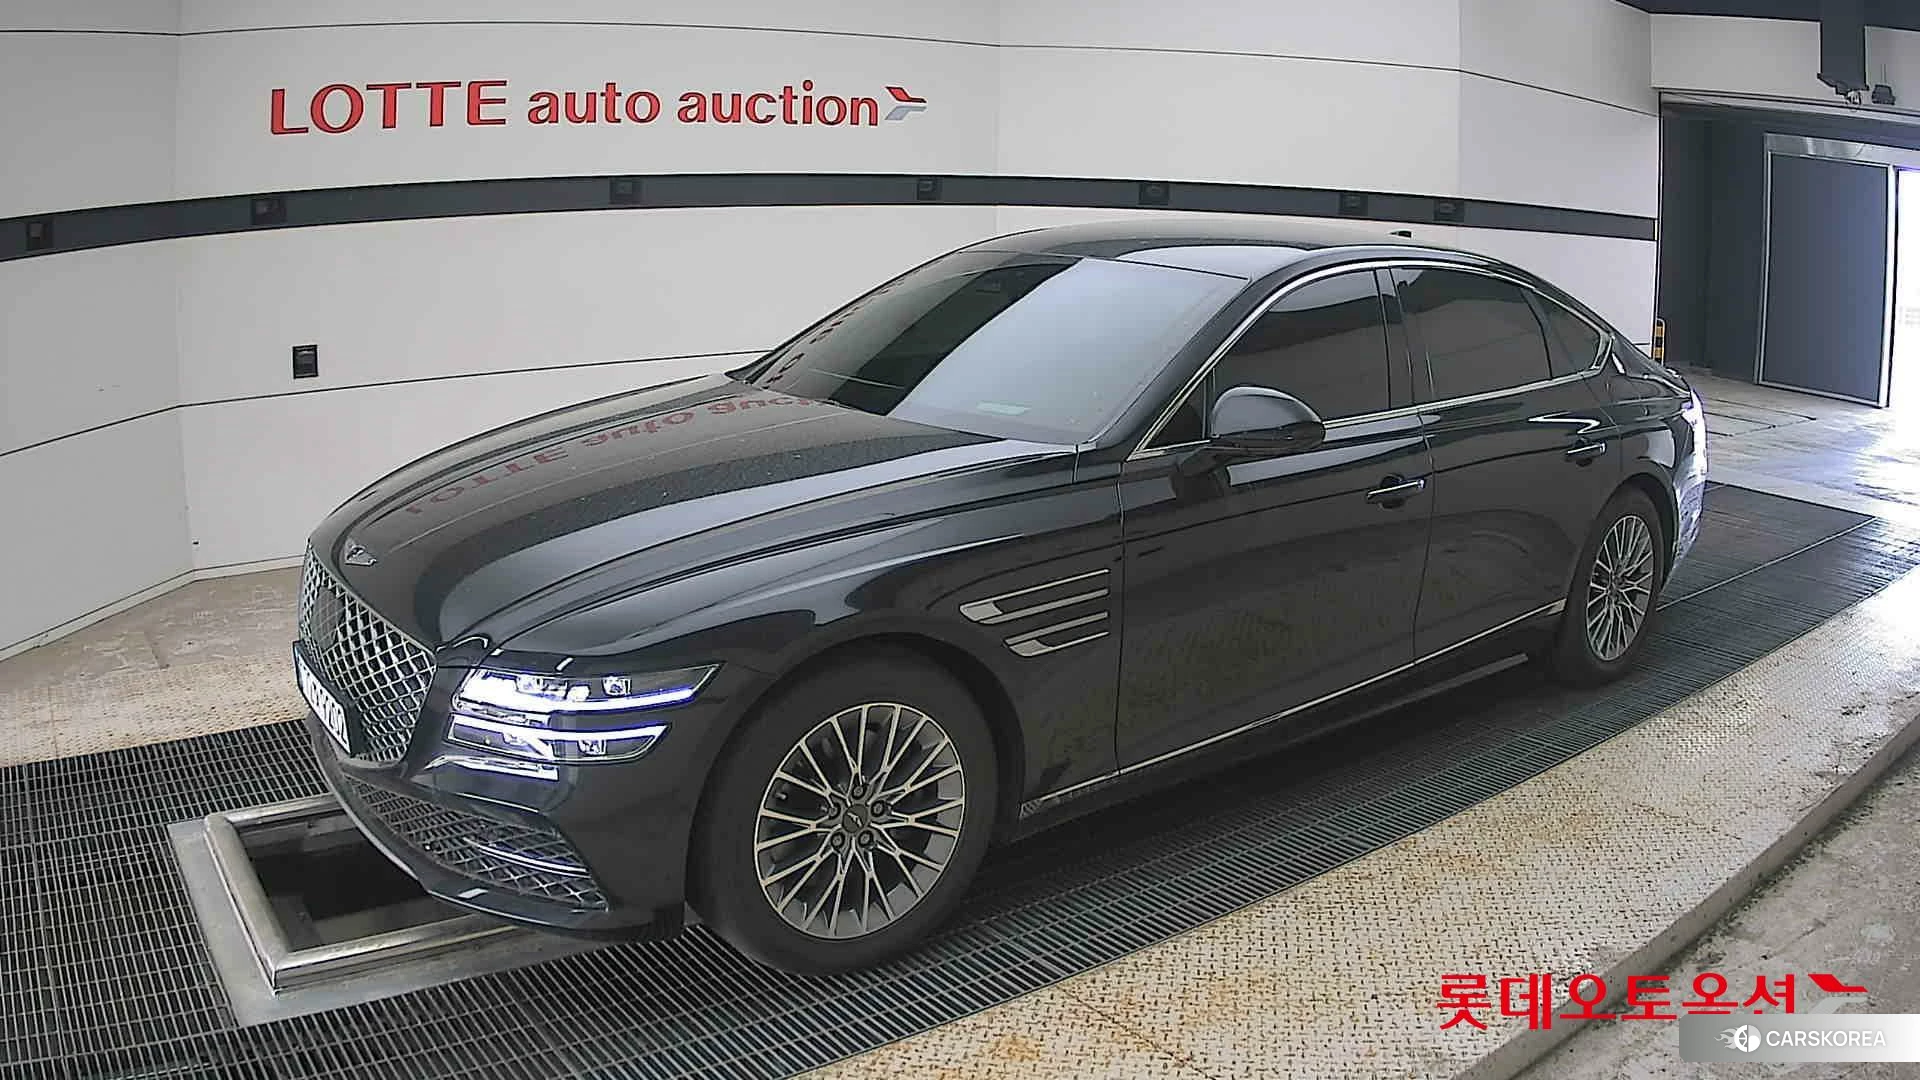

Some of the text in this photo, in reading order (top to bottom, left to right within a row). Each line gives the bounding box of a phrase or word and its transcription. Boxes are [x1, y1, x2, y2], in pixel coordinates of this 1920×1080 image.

[270, 79, 880, 136] LOTTE auto auction
